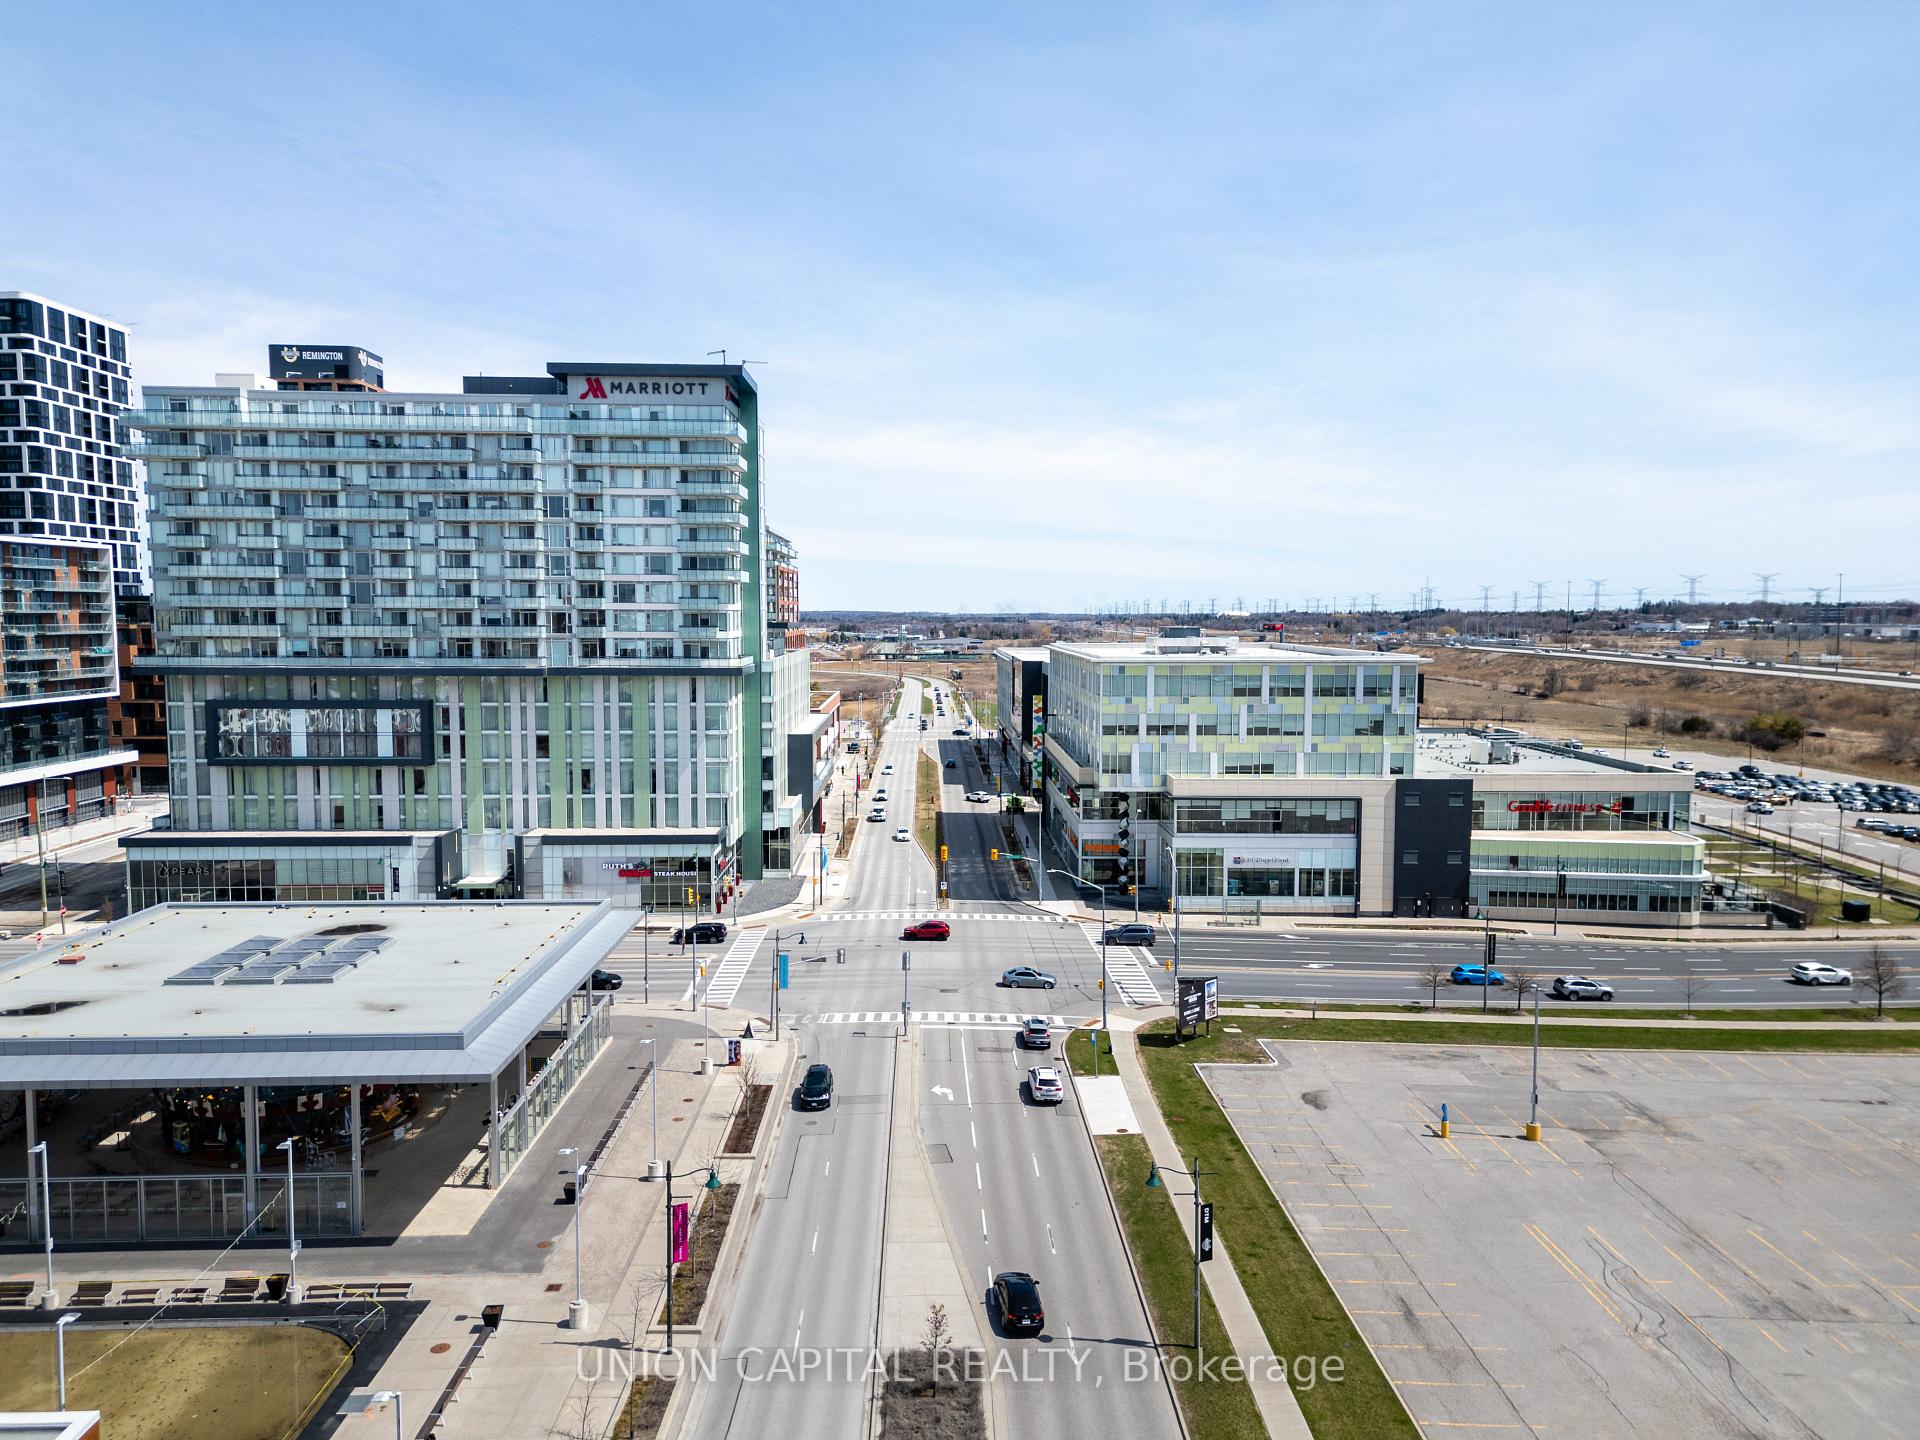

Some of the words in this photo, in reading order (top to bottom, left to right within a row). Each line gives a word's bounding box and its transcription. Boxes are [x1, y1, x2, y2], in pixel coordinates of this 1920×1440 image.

[302, 351, 343, 360] REMINGTON
[610, 382, 709, 395] MARRIOTT
[172, 867, 210, 876] PEARS
